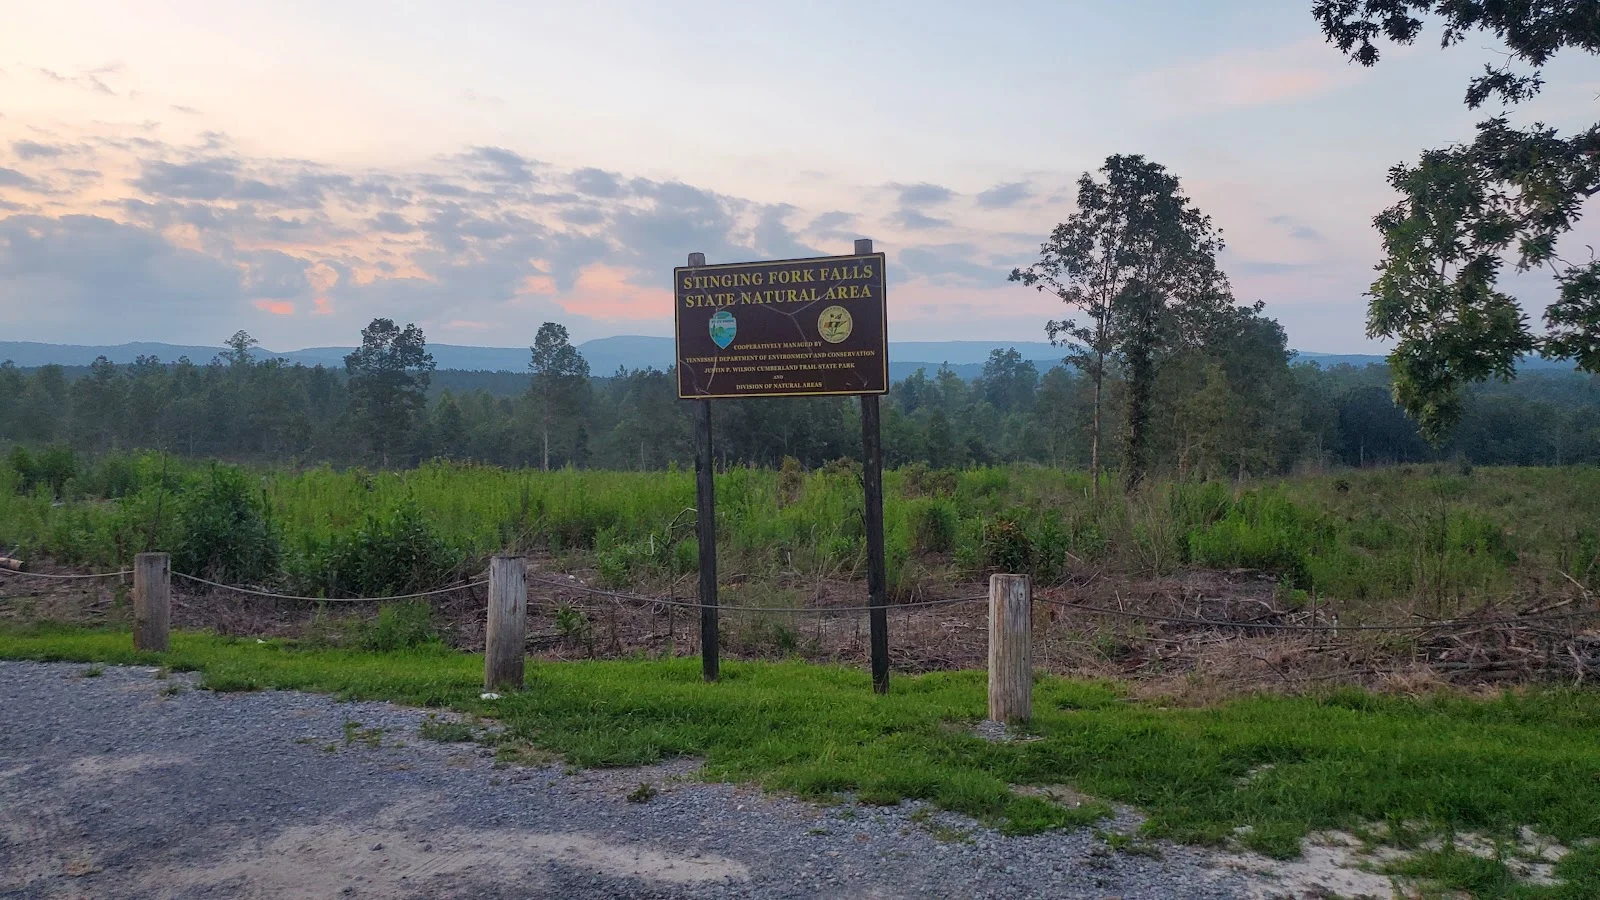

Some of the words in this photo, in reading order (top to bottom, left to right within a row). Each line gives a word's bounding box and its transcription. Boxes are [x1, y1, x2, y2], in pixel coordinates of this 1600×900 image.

[683, 272, 764, 290] STINGING
[768, 268, 815, 285] FORK
[819, 264, 874, 281] FALLS
[685, 293, 736, 308] STATE
[741, 288, 820, 305] NATURAL
[824, 284, 873, 300] AREA
[719, 354, 758, 362] DEPARTMENT
[768, 352, 813, 360] ENVIRONMENT
